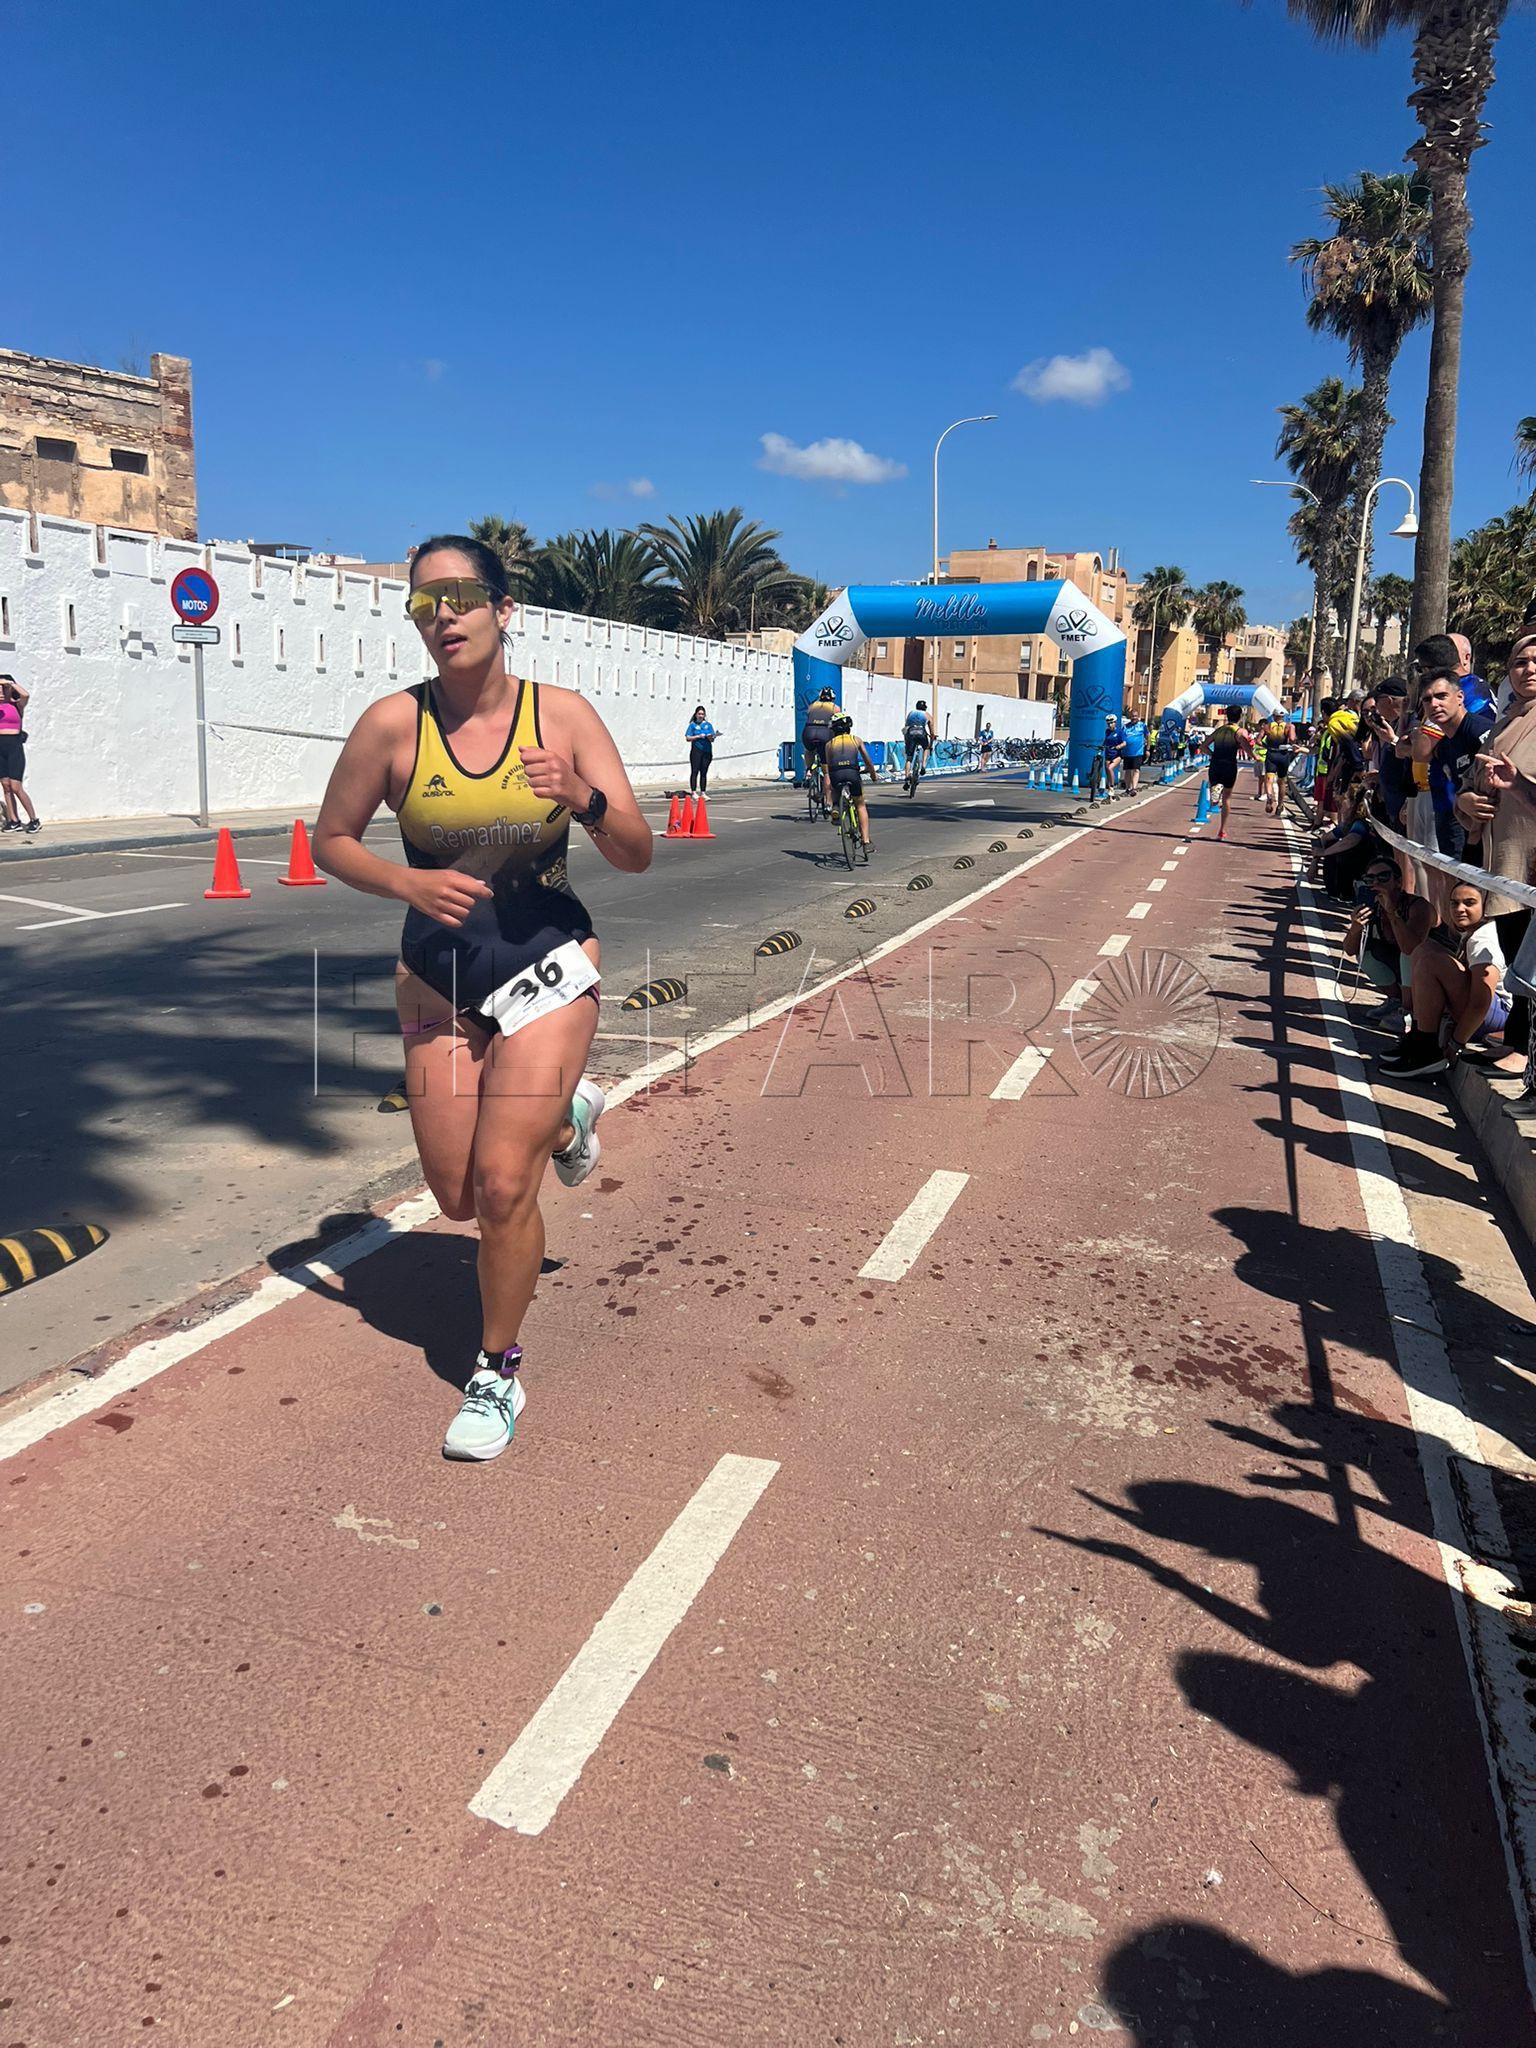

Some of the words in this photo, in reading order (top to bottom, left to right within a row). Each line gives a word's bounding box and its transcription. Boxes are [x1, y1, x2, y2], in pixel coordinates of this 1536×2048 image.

[182, 600, 208, 611] MOTOS
[914, 592, 988, 621] Melilla
[818, 639, 843, 647] FMET
[1061, 634, 1087, 642] FMET
[509, 958, 564, 1008] 36
